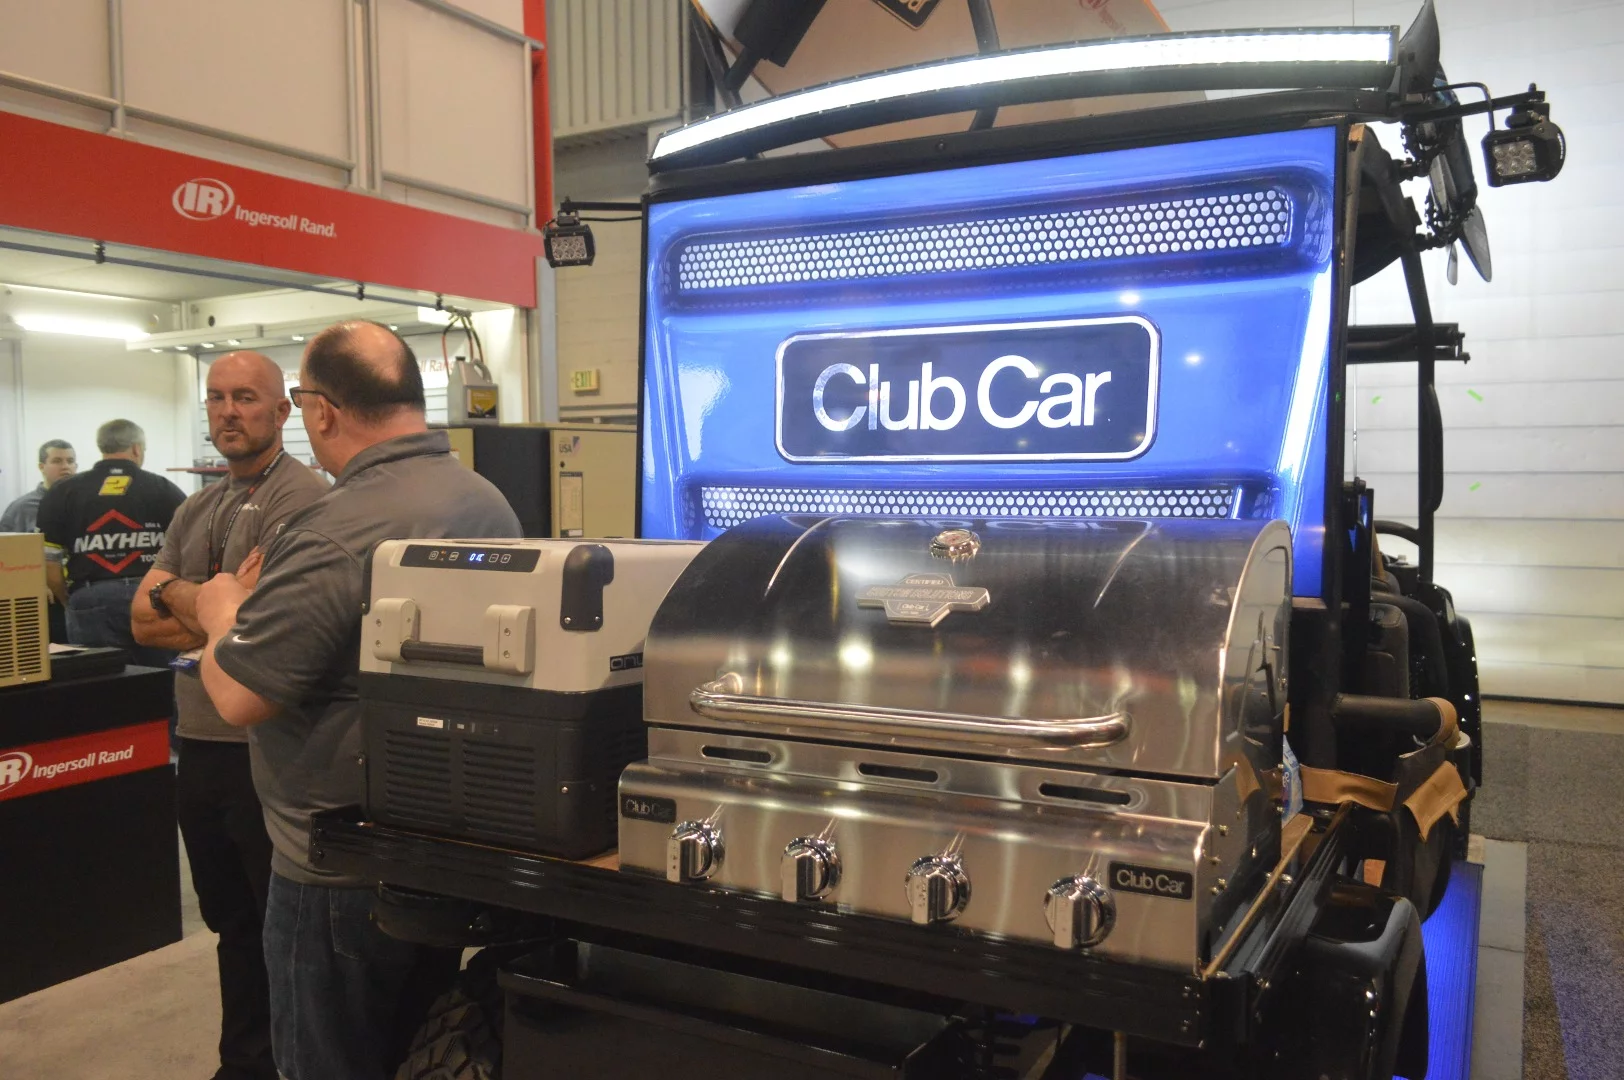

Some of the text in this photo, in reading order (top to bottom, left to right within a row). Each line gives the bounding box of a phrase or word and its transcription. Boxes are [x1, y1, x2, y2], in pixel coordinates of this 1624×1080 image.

[183, 181, 225, 216] IR
[235, 205, 335, 238] Ingersoll Rand
[574, 371, 593, 388] EXIT
[812, 354, 1112, 433] Club Car
[559, 443, 572, 453] USA
[98, 475, 133, 496] 2
[32, 745, 134, 779] Ingersoll Rand
[625, 799, 651, 815] Club
[1116, 869, 1185, 894] Club Car
